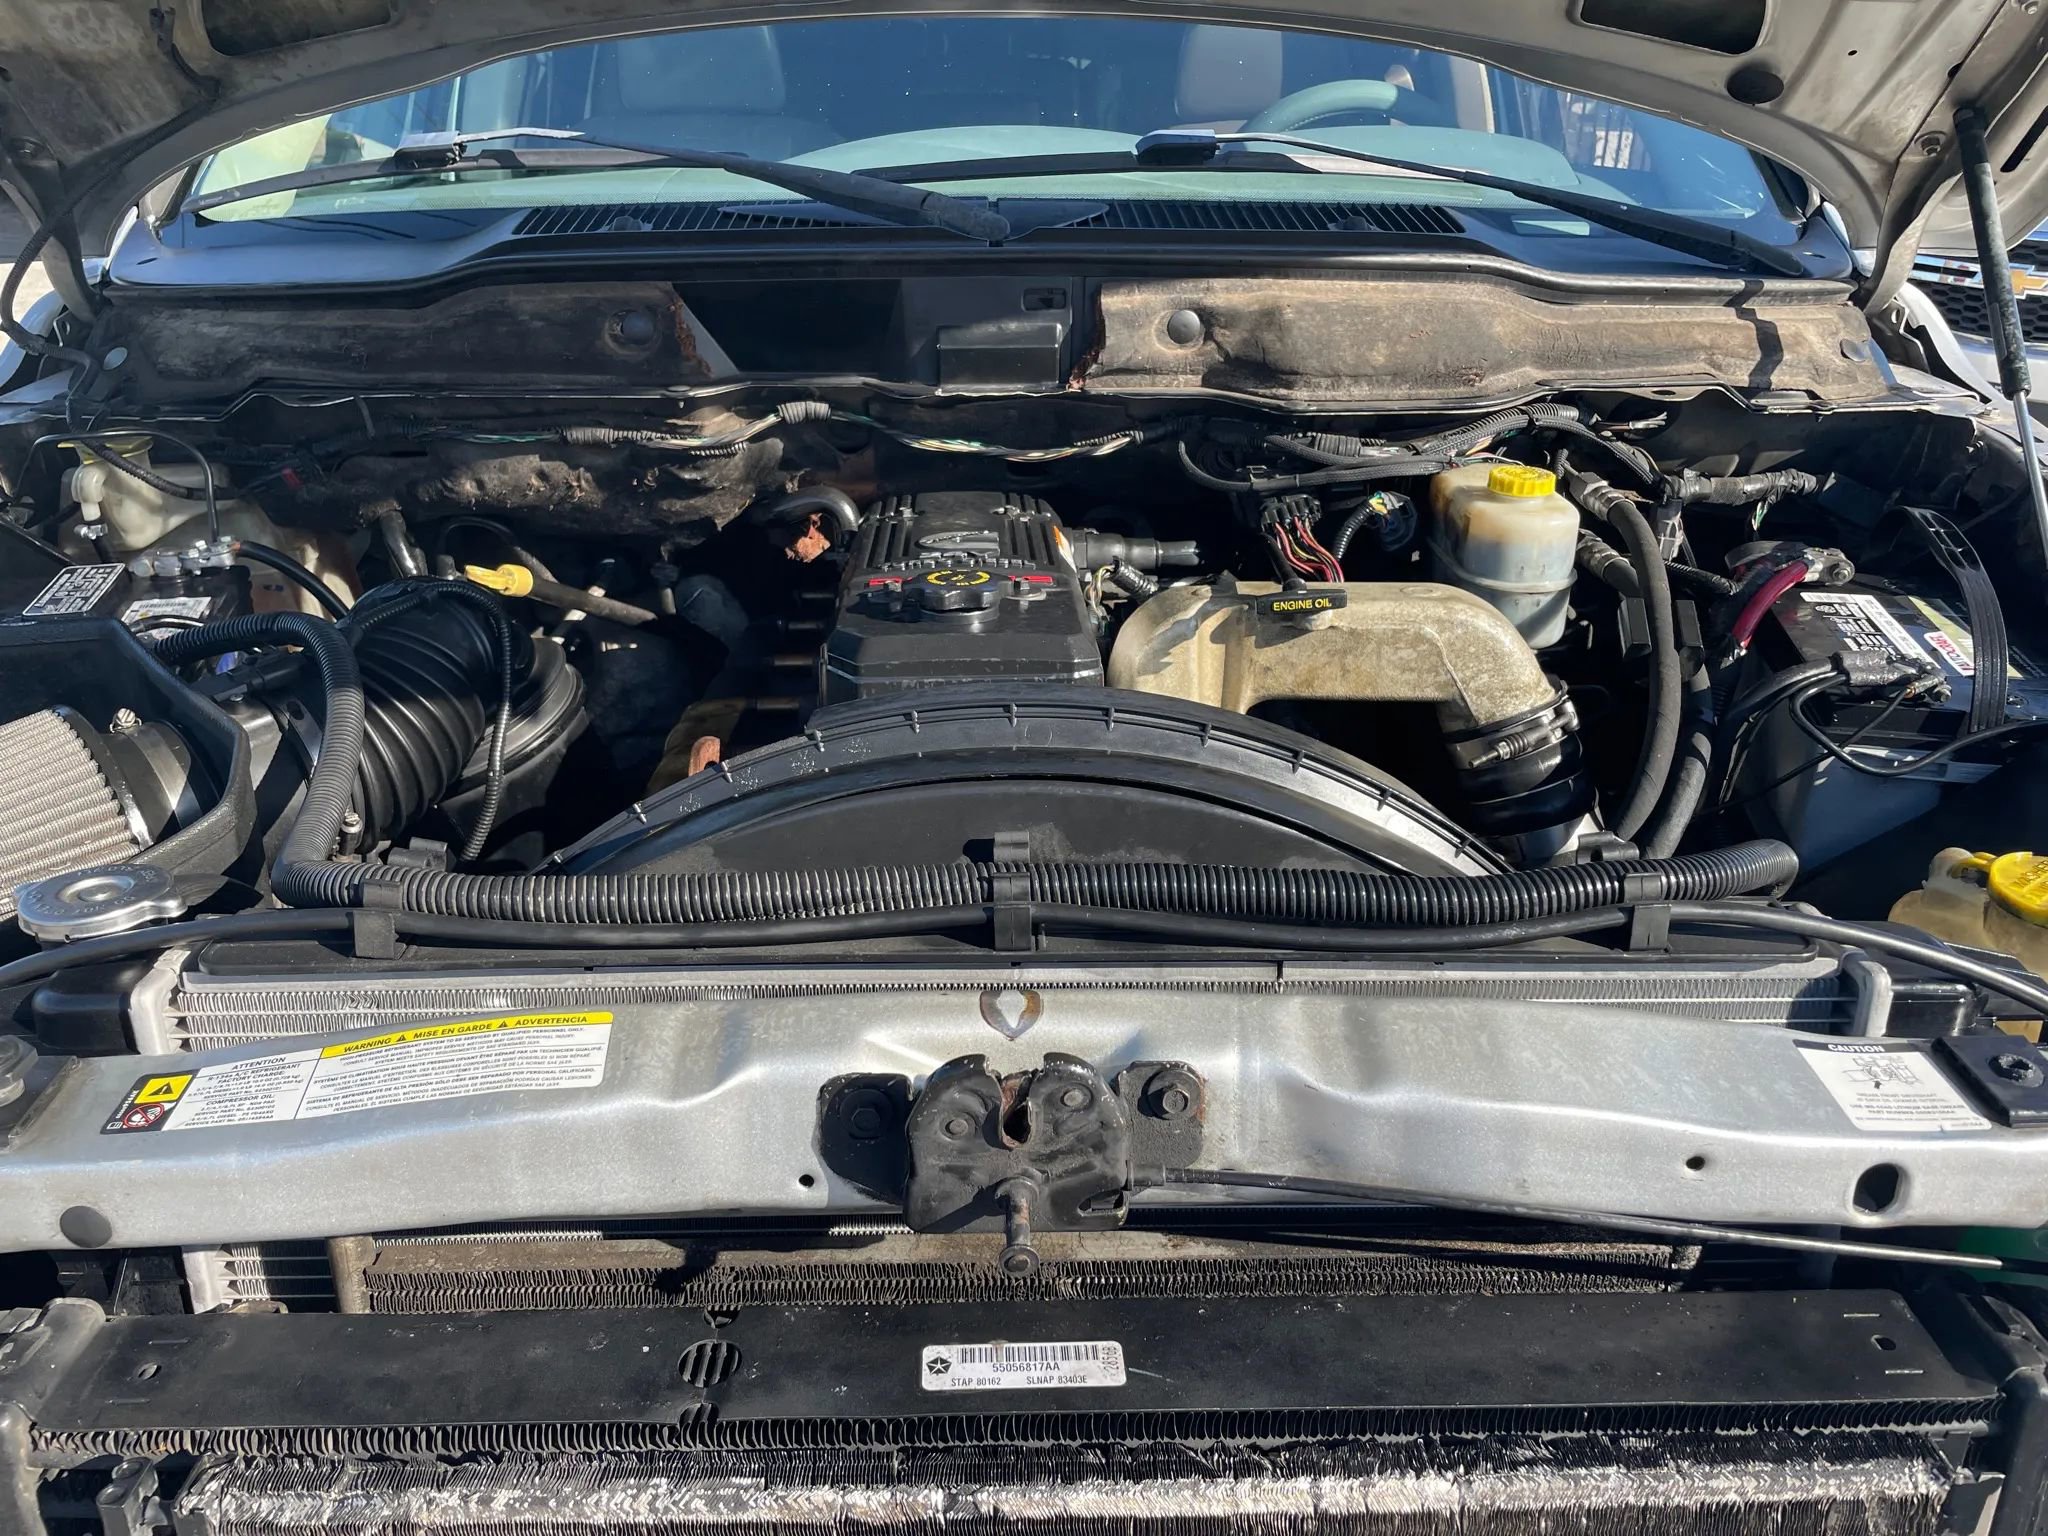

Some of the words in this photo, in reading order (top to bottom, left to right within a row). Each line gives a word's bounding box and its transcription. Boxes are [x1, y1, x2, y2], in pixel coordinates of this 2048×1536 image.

[1273, 599, 1312, 611] ENGINE
[1315, 597, 1332, 608] OIL
[343, 1038, 391, 1052] WARNING
[413, 1029, 439, 1038] MISE
[457, 1023, 492, 1032] GARDE
[514, 1016, 587, 1025] ADVERTENCIA
[1827, 1044, 1885, 1053] CAUTION
[231, 1057, 286, 1069] ATTENTION
[992, 1362, 1060, 1373] 55056817AA
[951, 1378, 973, 1387] STAP
[976, 1377, 1001, 1386] 80162
[1026, 1375, 1055, 1385] SLNAP
[1057, 1375, 1088, 1384] 83403E
